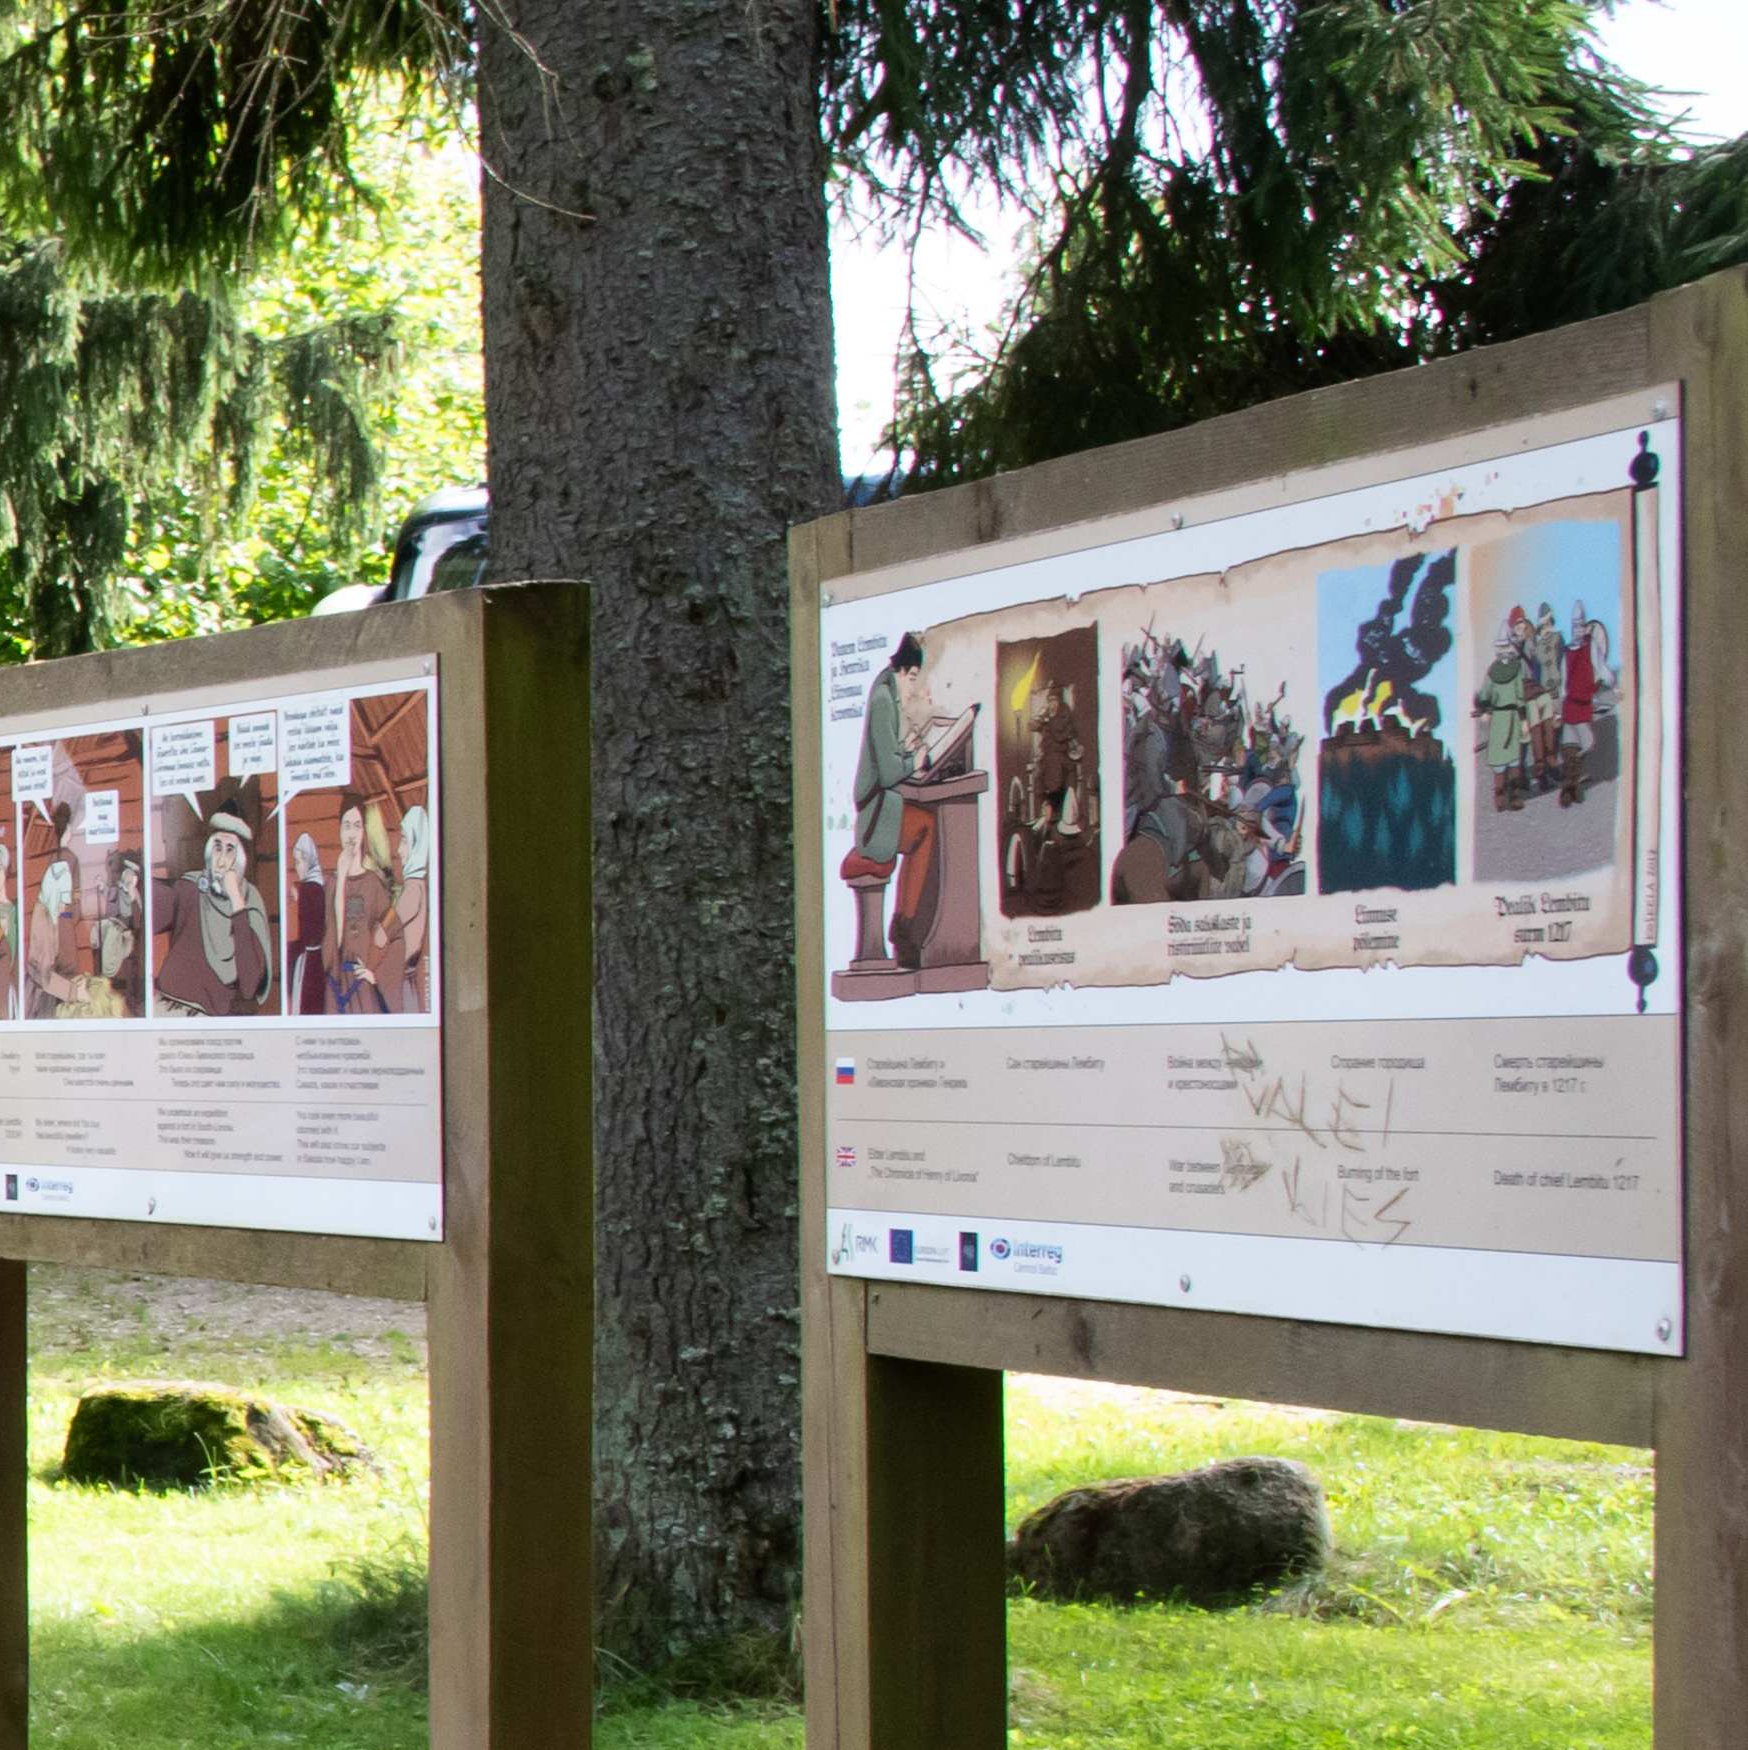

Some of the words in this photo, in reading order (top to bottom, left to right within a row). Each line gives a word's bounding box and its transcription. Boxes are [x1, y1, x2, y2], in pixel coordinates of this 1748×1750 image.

[1541, 892, 1591, 914] Lembitu
[1548, 921, 1572, 942] 1217
[1552, 1077, 1578, 1093] 1217
[1336, 1164, 1371, 1183] Burning
[1374, 1165, 1384, 1180] of
[1385, 1166, 1400, 1181] the
[1402, 1166, 1419, 1181] fort
[1494, 1170, 1523, 1185] Death
[1526, 1171, 1538, 1186] of
[1540, 1172, 1568, 1187] chief
[1569, 1173, 1609, 1190] Lembitu
[1613, 1174, 1640, 1190] 1217
[1013, 1239, 1064, 1264] Interreg
